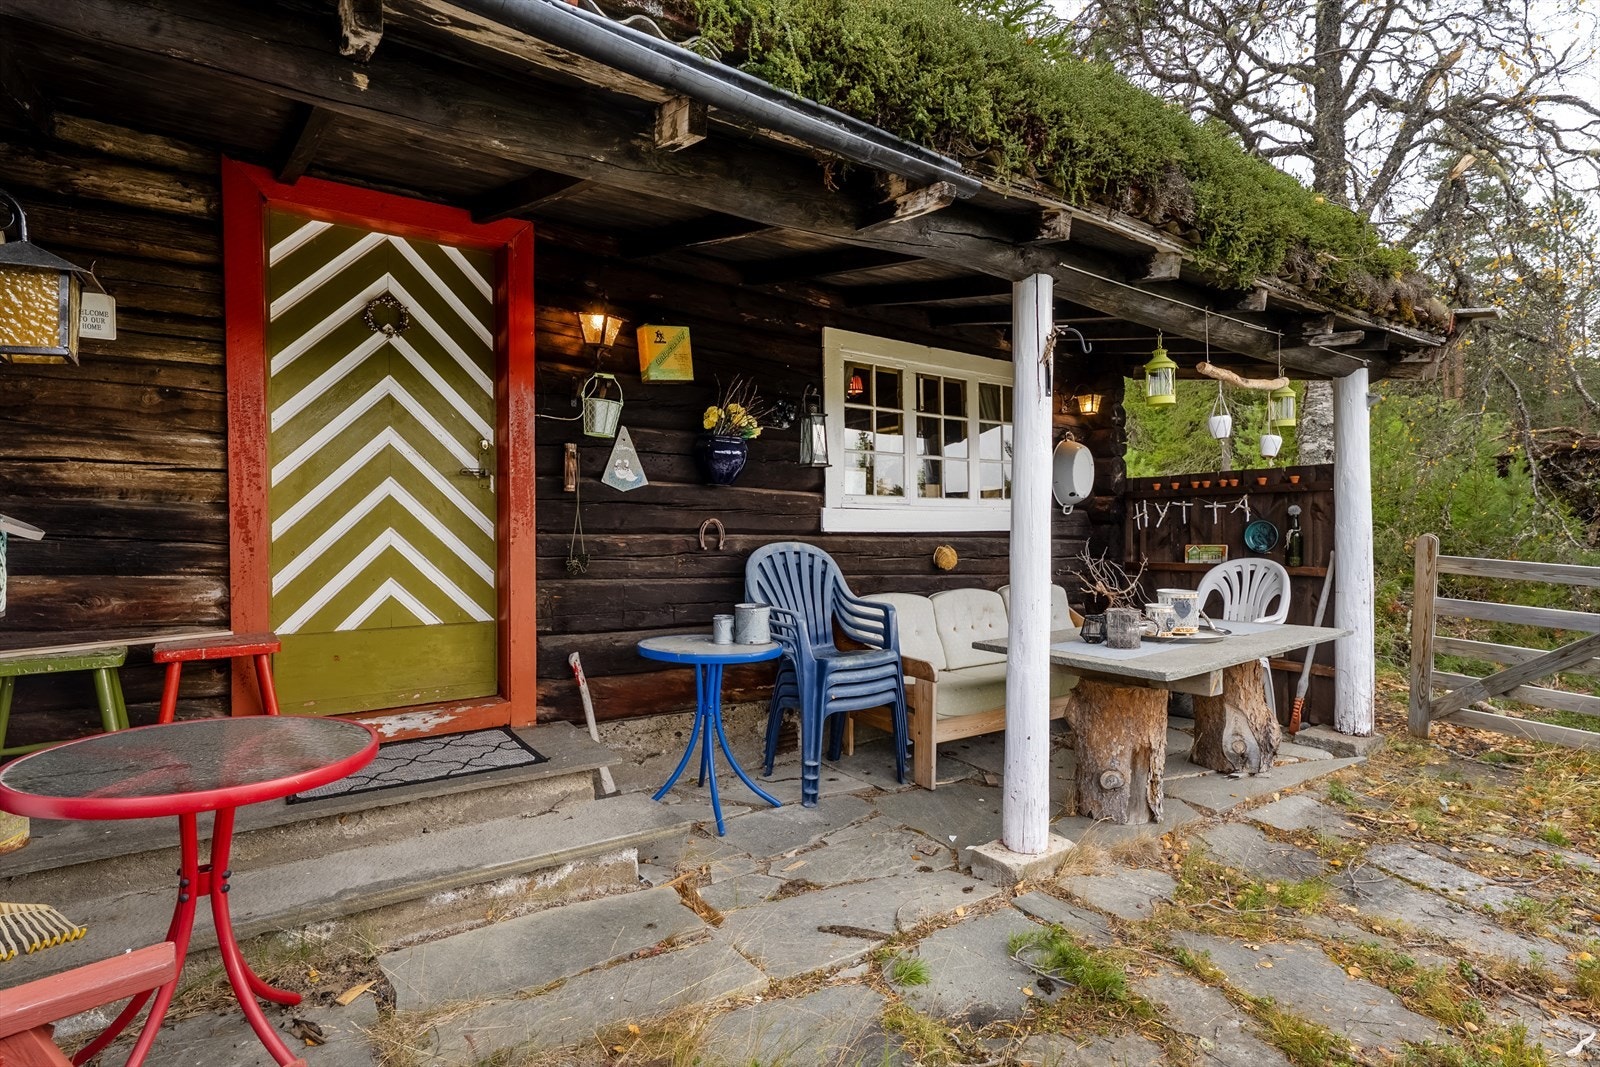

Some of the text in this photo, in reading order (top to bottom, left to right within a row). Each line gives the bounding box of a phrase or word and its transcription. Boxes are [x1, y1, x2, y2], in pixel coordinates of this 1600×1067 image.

[80, 309, 109, 317] ELCOME
[82, 323, 102, 331] HOME
[1133, 494, 1251, 530] HYTTA
